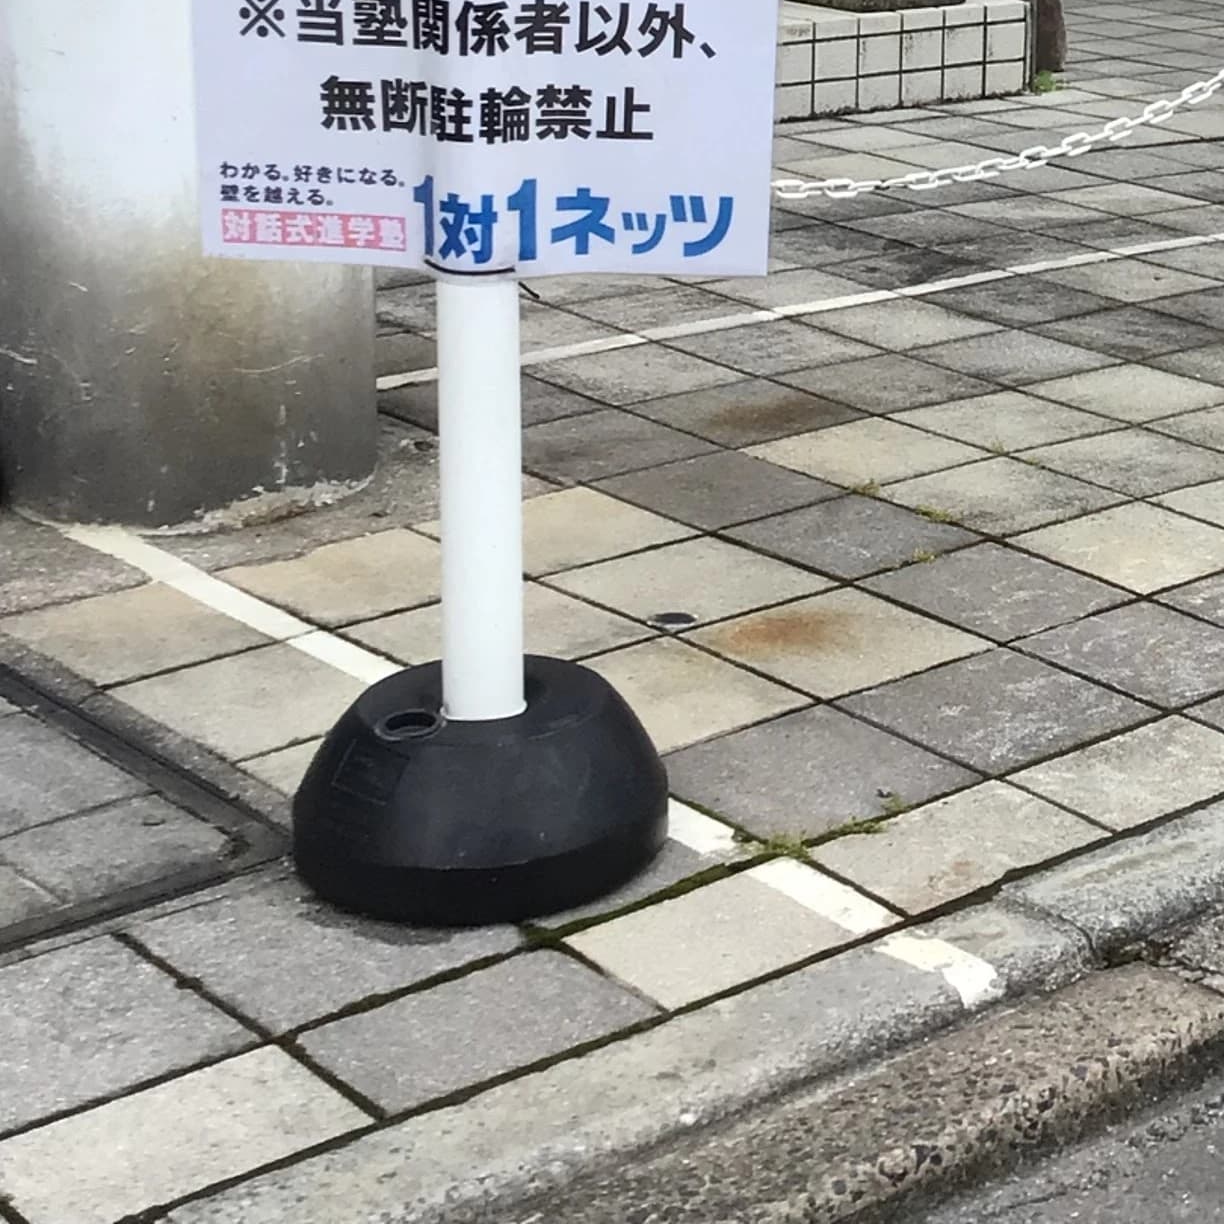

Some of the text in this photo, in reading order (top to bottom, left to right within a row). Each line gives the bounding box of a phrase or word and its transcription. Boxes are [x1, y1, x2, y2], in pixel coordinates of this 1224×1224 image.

[319, 75, 655, 145] 無断駐輪禁止
[222, 209, 406, 251] 対話式進学塾
[412, 175, 735, 264] 1対1ネッツ
